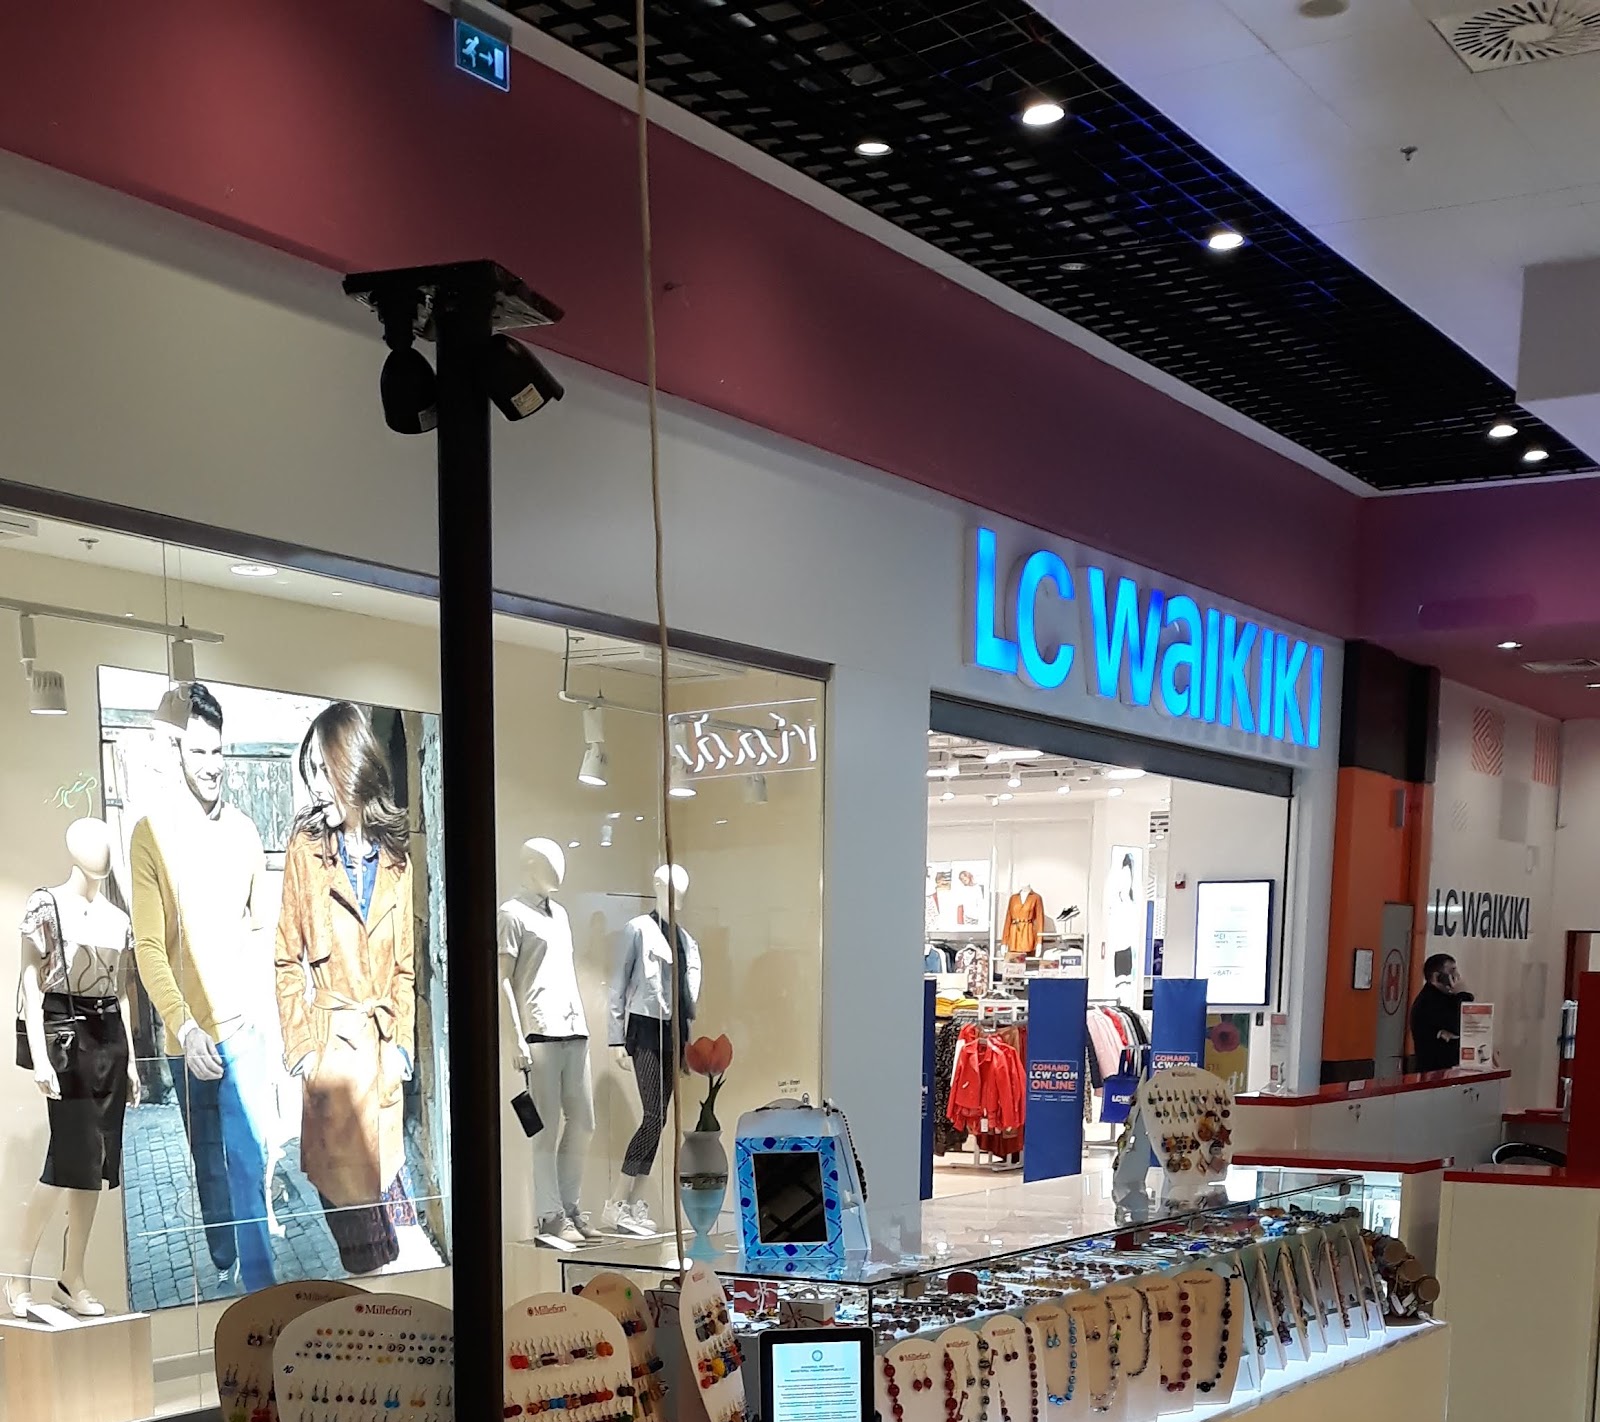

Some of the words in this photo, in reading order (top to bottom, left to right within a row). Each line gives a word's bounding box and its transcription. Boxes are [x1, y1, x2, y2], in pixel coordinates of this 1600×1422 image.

[976, 527, 1075, 689] LC
[1434, 888, 1459, 937] LC
[1032, 1063, 1070, 1071] COMAND
[1031, 1080, 1076, 1090] ONLINE
[365, 1304, 412, 1316] Millefiori
